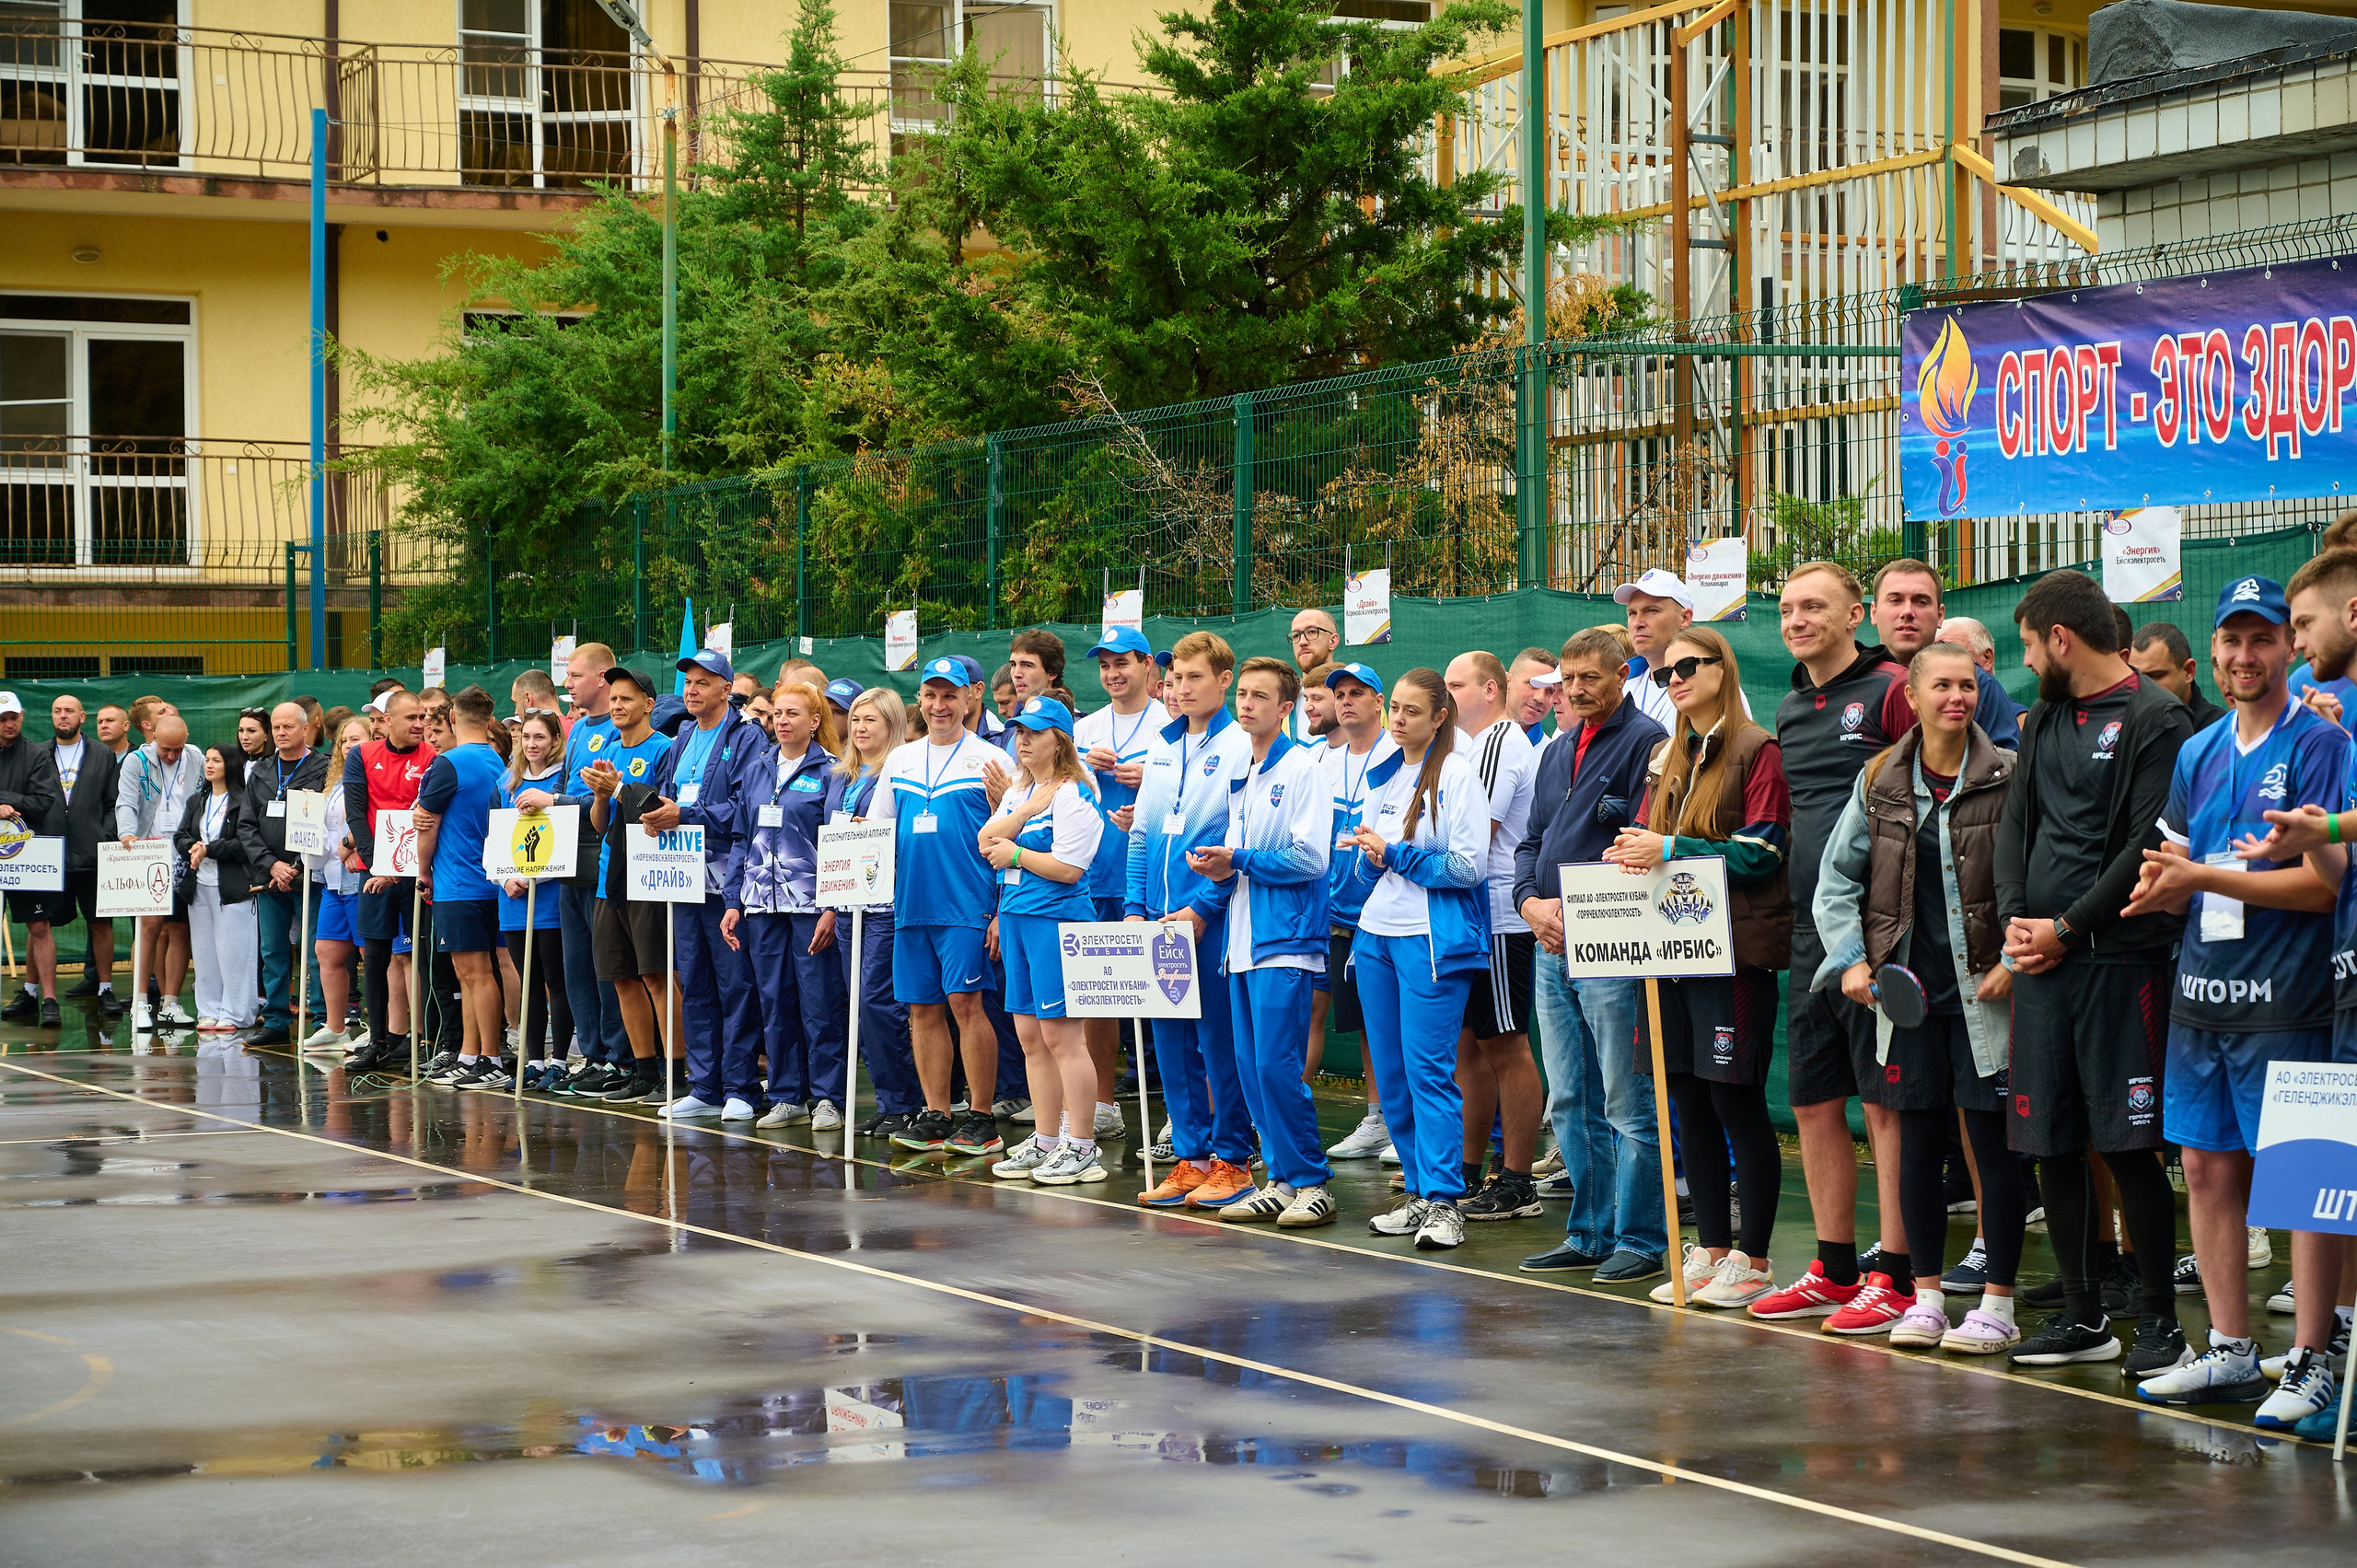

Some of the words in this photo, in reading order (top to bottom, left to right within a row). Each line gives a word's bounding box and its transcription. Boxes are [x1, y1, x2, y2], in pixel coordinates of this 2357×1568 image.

[1995, 340, 2122, 459] СПОРТ
[2151, 328, 2235, 447] ЭТО
[2241, 315, 2357, 461] ЗДОР
[2121, 545, 2161, 557] «Энергия»
[2116, 555, 2166, 566] Ейскэлектросеть
[1687, 572, 1712, 582] «Энергия
[1712, 572, 1745, 581] движения»
[1356, 598, 1377, 610] «Драйв»
[0, 832, 30, 843] НАДО
[289, 830, 319, 848] «ФАКЕЛ»
[658, 830, 702, 852] DRIVE
[821, 829, 868, 842] ИСПОЛНИТЕЛЬНЫЙ
[868, 828, 891, 838] АППАРАТ
[632, 853, 698, 863] «КОРЕНОВСКЭЛЕКТРОСЕТЬ»
[525, 865, 565, 873] НАПРЯЖЕНИЯ
[820, 859, 851, 873] «ЭНЕРГИЯ
[100, 877, 145, 890] «АЛЬФА»
[640, 866, 692, 890] «ДРАЙВ»
[819, 878, 858, 895] ДВИЖЕНИЯ»
[1567, 892, 1586, 904] ФИЛИАЛ
[1586, 892, 1594, 903] АО
[1594, 891, 1628, 903] «ЭЛЕКТРОСЕТИ
[1629, 890, 1649, 901] КУБАНИ»
[1575, 908, 1643, 920] «ГОРЯЧЕКЛЮЧЭЛЕКТРОСЕТЬ»
[1082, 935, 1143, 946] ЭЛЕКТРОСЕТИ
[1083, 947, 1144, 956] КУБАНИ
[1574, 941, 1652, 965] КОМАНДА
[1656, 938, 1723, 960] «ИРБИС»
[1103, 966, 1112, 976] АО
[1067, 981, 1119, 992] «ЭЛЕКТРОСЕТИ
[1120, 980, 1150, 991] КУБАНИ»
[2180, 973, 2272, 1004] ШТОРМ
[1074, 994, 1145, 1005] «ЕЙСКЭЛЕКТРОСЕТЬ»
[2128, 1076, 2154, 1085] ИРБИС
[2275, 1071, 2291, 1085] АО
[2272, 1090, 2357, 1107] «ГЕЛЕНДЖИКЭЛ
[2313, 1188, 2357, 1221] ШТ
